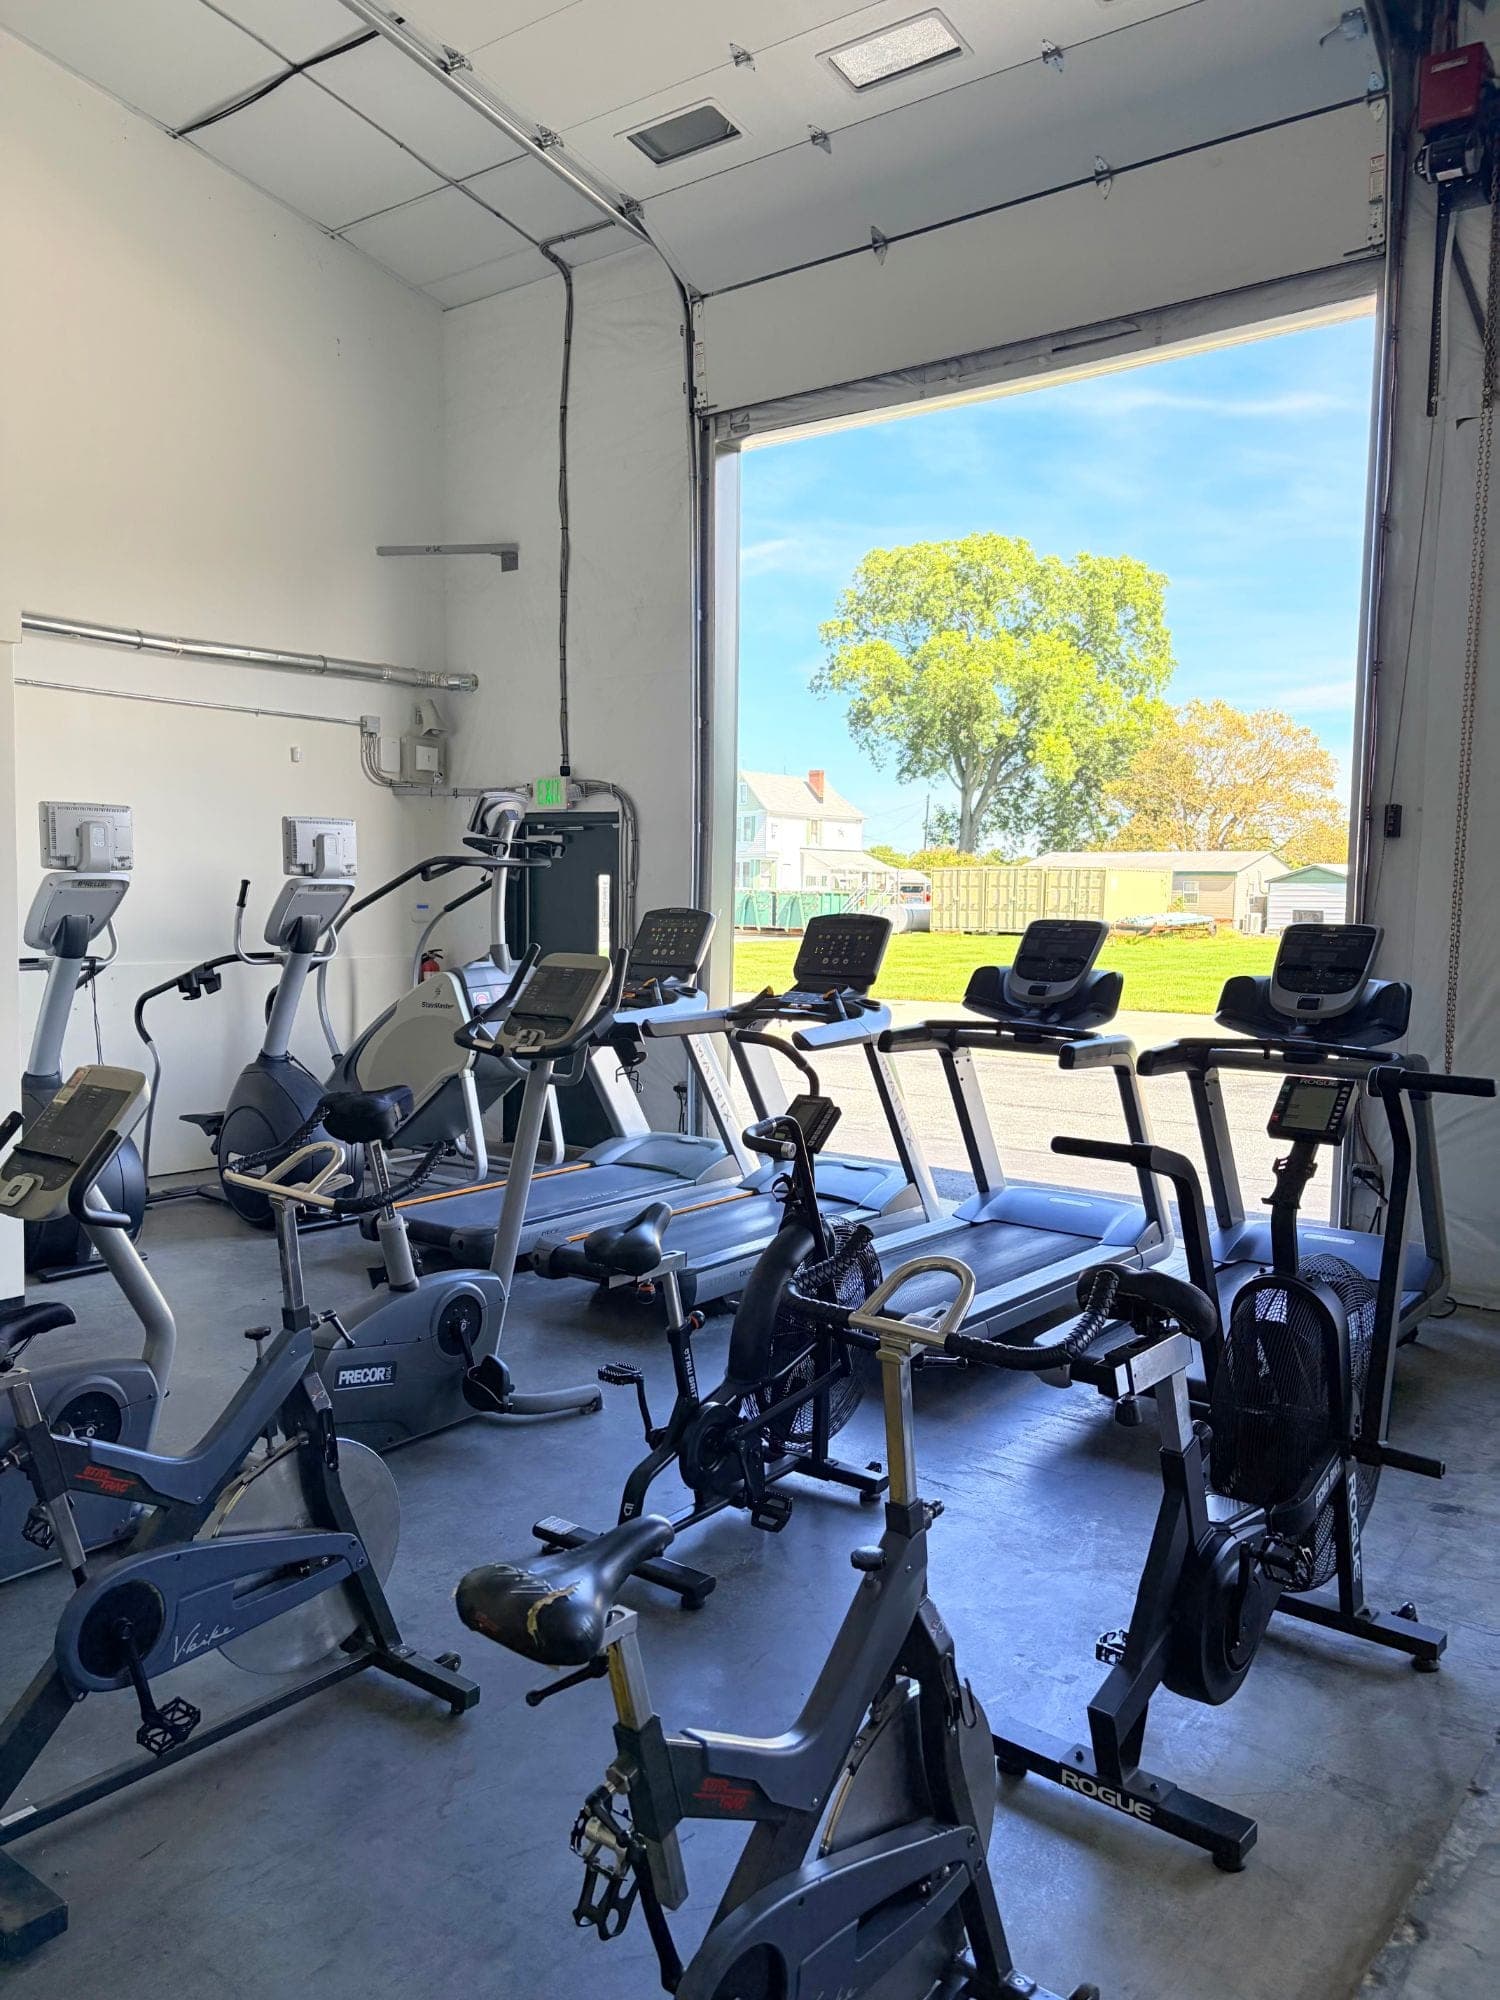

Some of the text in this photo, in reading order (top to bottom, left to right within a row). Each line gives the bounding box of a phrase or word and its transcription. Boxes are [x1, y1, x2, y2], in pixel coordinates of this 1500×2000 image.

[536, 778, 562, 807] EXIT
[338, 1367, 386, 1385] PRECOR
[1348, 1471, 1362, 1582] ROGUE
[1061, 1768, 1153, 1822] ROGUE
